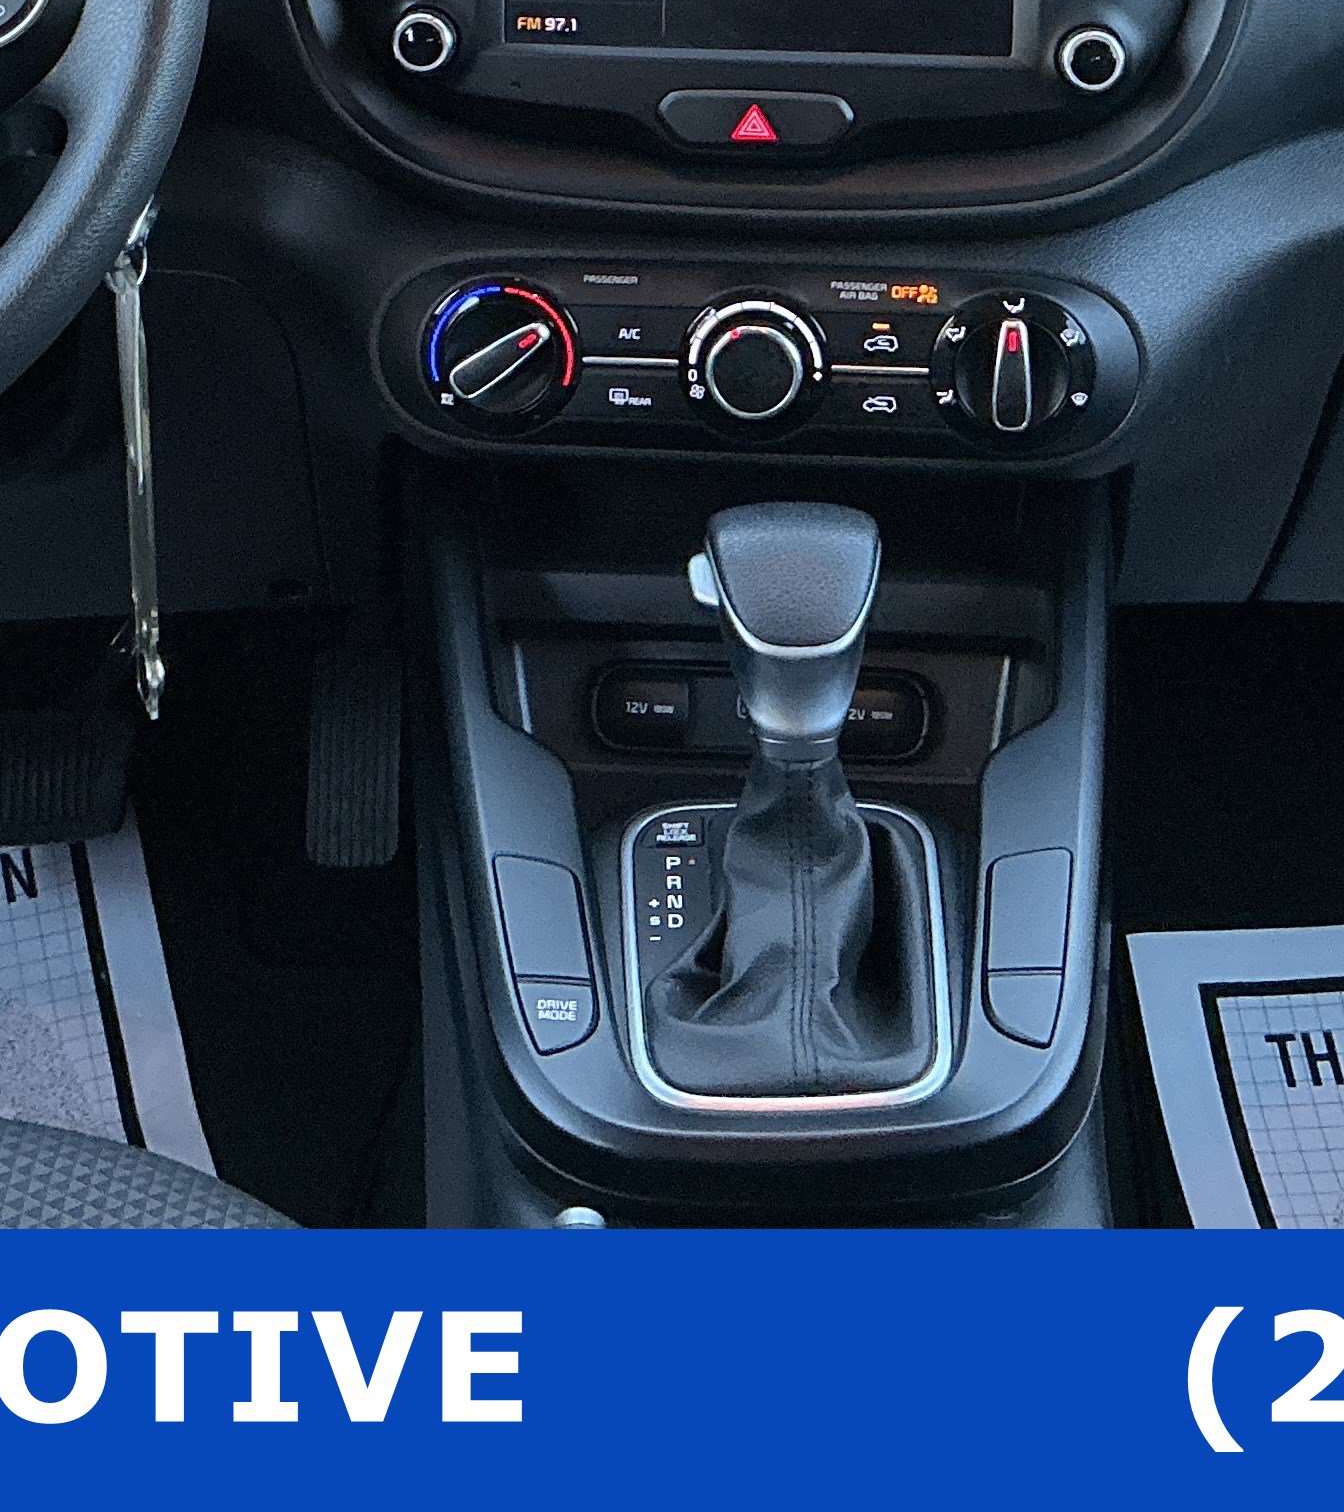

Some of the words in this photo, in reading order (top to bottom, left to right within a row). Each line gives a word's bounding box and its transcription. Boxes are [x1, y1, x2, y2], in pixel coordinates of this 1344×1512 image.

[517, 17, 542, 31] FM
[544, 17, 578, 33] 97.1
[830, 280, 888, 292] PASSENGER
[890, 285, 918, 299] OFF
[839, 290, 857, 300] AIR
[857, 291, 879, 300] BAG
[618, 328, 641, 340] A/C
[625, 701, 648, 714] 12V
[847, 709, 866, 720] 2V
[665, 856, 682, 871] P
[666, 875, 682, 890] R
[667, 894, 683, 909] N
[667, 913, 684, 929] D
[537, 999, 578, 1011] DRIVE
[538, 1009, 577, 1021] MODE
